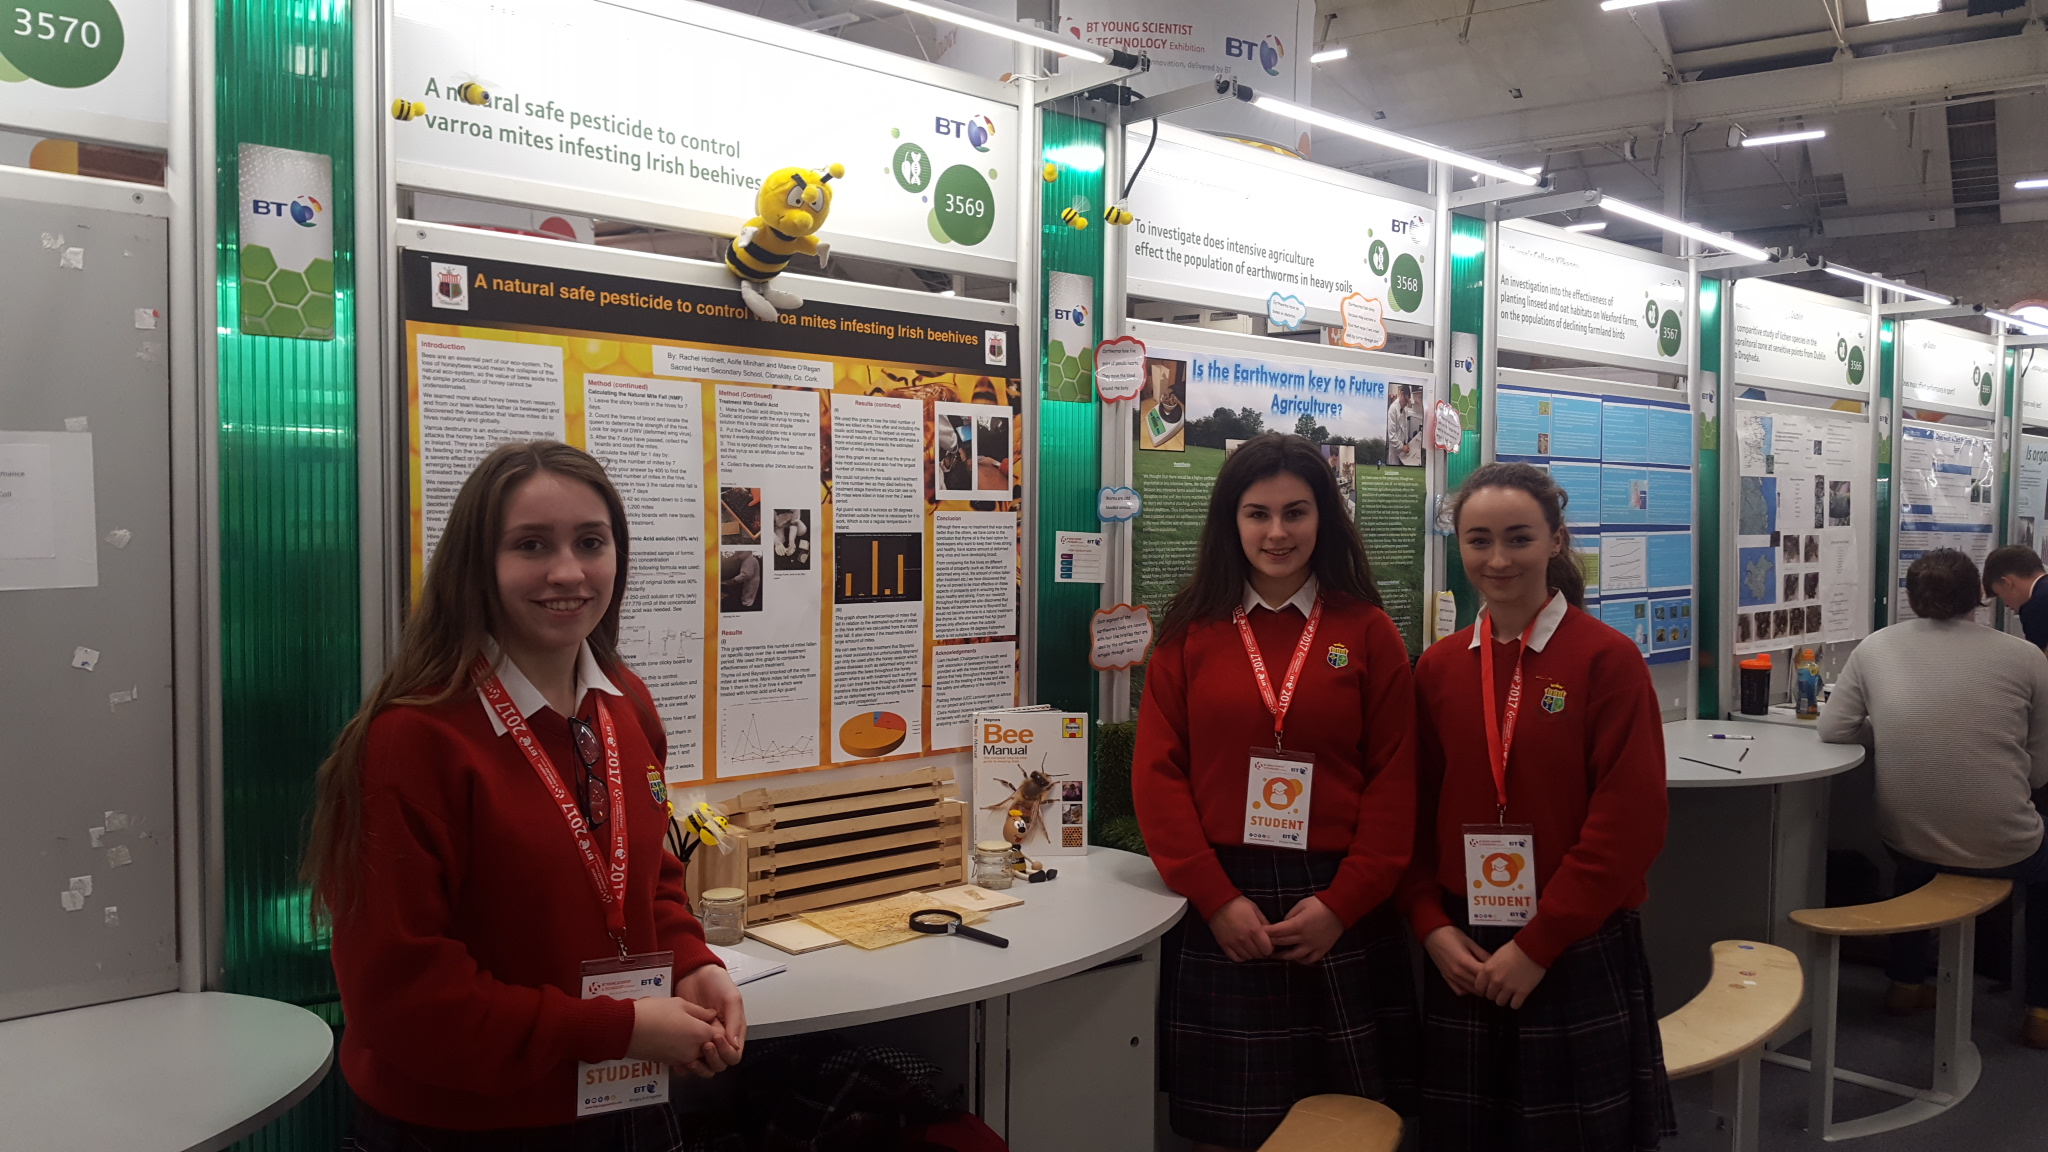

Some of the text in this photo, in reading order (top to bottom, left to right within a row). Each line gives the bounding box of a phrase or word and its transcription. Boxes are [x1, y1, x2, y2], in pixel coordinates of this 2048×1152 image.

[14, 8, 101, 48] 3570
[1087, 22, 1193, 36] BT YOUNG SCIENTIST
[1169, 42, 1205, 53] Exhibition
[1226, 37, 1258, 60] BT
[425, 77, 440, 98] A
[525, 101, 565, 123] safe
[570, 111, 653, 141] pesticide
[657, 127, 676, 145] to
[681, 135, 740, 159] control
[935, 116, 966, 139] BT
[425, 114, 762, 191] varroa mites infesting Irish beehives
[252, 199, 288, 218] BT
[945, 194, 984, 218] 3569
[1392, 219, 1408, 235] BT
[1135, 218, 1315, 267] To investigate does intensive agriculture
[1135, 241, 1352, 293] effect the population of earthworms in heavy soils
[1396, 275, 1418, 293] 3568
[1500, 274, 1614, 306] An investigation into the effectiveness of
[474, 273, 488, 289] A
[493, 278, 554, 297] natural
[560, 285, 596, 301] safe
[600, 291, 673, 311] pesticide
[676, 298, 692, 313] to
[697, 303, 749, 319] control
[801, 314, 837, 329] mites
[841, 318, 894, 339] infesting
[898, 325, 924, 339] Irish
[927, 327, 979, 345] beehives
[1055, 309, 1071, 320] BT
[1500, 291, 1638, 328] planting linseed and oat habitats on Wexford farms,
[1500, 310, 1625, 339] on the populations of declining farmland birds
[1662, 326, 1678, 340] 3567
[421, 341, 466, 351] Introduction
[667, 352, 678, 361] By:
[701, 356, 726, 364] Hodnett,
[727, 358, 742, 366] Aoife
[742, 359, 765, 367] Minihan
[778, 363, 796, 371] Maeve
[797, 364, 821, 373] O'Regan
[670, 363, 692, 372] Sacred
[693, 365, 710, 373] Heart
[710, 367, 742, 377] Secondary
[742, 370, 764, 379] School,
[765, 372, 793, 382] Clonakilty,
[794, 374, 802, 382] Co.
[1454, 360, 1465, 368] BT
[1850, 360, 1862, 371] 3566
[588, 380, 649, 391] Method (continued)
[1192, 359, 1385, 394] Is the Earthworm key to Future
[741, 392, 773, 400] (Continued)
[1271, 394, 1343, 415] Agriculture?
[2032, 450, 2048, 465] orga
[1299, 631, 1313, 651] 2017
[1251, 654, 1265, 673] 2017
[1279, 690, 1292, 712] 2017
[1508, 684, 1521, 708] 2017
[494, 702, 527, 735] 2017
[984, 723, 1034, 744] Bee
[983, 745, 1028, 756] Manual
[607, 750, 621, 785] 2017
[562, 803, 587, 838] 2017
[1250, 815, 1305, 831] STUDENT
[1473, 895, 1532, 907] STUDENT
[641, 978, 653, 987] BT
[585, 1061, 662, 1086] STUDENT
[634, 1085, 646, 1095] BT
